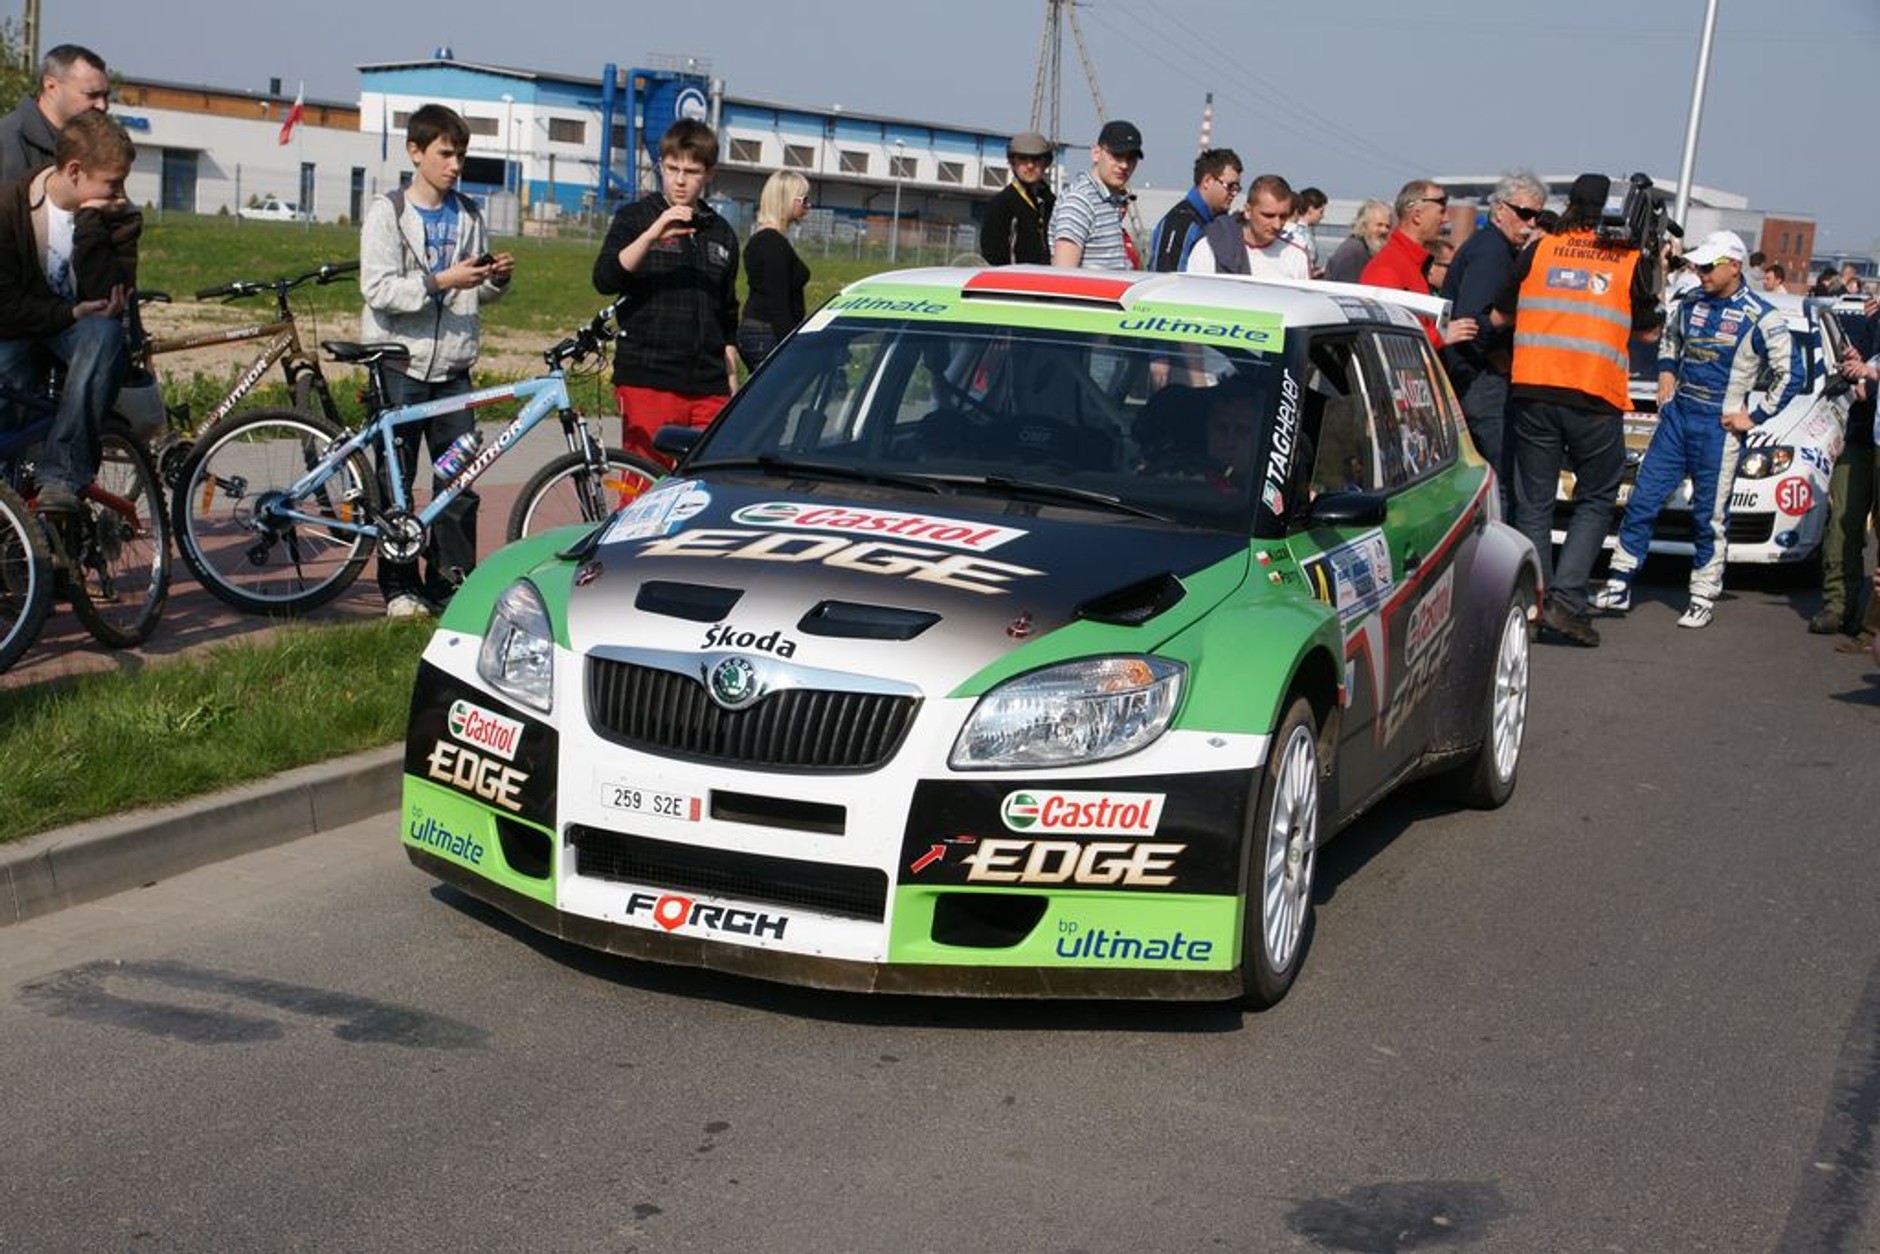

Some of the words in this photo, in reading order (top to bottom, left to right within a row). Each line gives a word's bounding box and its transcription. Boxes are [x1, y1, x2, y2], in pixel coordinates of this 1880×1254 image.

[1118, 316, 1269, 344] ultimate
[218, 357, 268, 419] AUTHOR
[459, 417, 524, 489] AUTHOR
[1780, 479, 1810, 510] STP
[793, 505, 1002, 546] Castrol
[635, 528, 1049, 596] EDGE
[700, 624, 797, 658] Škoda
[464, 710, 518, 754] Castrol
[426, 739, 530, 812] EDGE
[613, 788, 643, 810] 259
[653, 795, 683, 817] S2E
[1041, 794, 1153, 830] Castrol
[410, 817, 485, 866] ultimate
[960, 838, 1189, 887] EDGE
[1055, 929, 1214, 962] ultimate
[1058, 919, 1079, 933] bp
